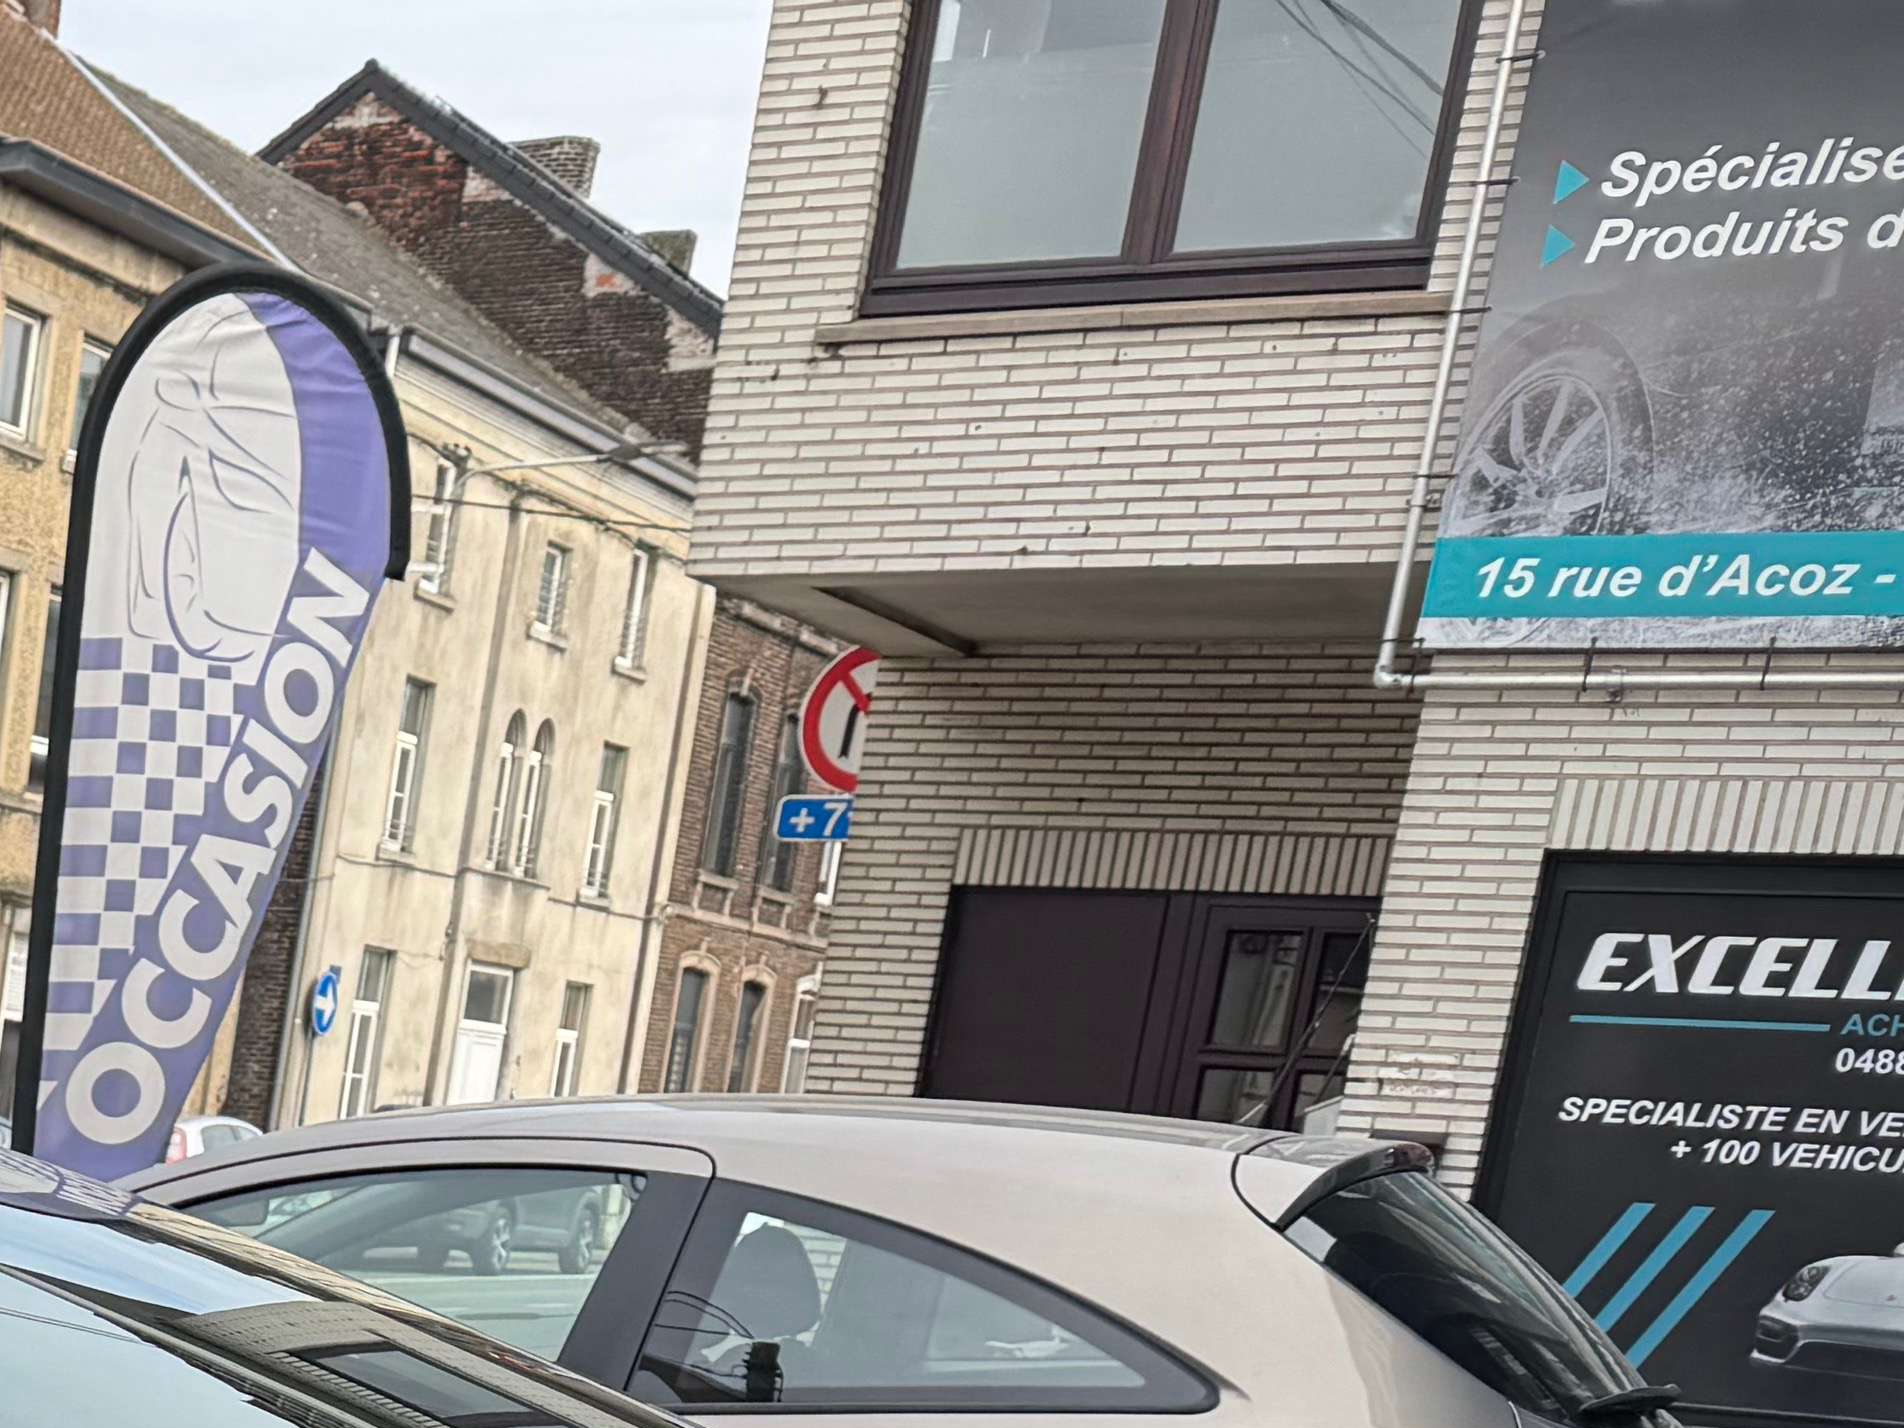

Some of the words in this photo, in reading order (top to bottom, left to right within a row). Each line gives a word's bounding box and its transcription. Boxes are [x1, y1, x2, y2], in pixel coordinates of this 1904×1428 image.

[1584, 208, 1849, 263] Produits
[1475, 558, 1540, 598] 15
[1547, 565, 1642, 598] rue
[1658, 553, 1861, 598] d'Acoz
[822, 802, 853, 837] 7
[65, 546, 371, 1146] OCCASION
[1558, 1097, 1791, 1132] SPECIALISTE
[1793, 1108, 1850, 1134] EN
[1859, 1110, 1904, 1138] VE
[1701, 1139, 1760, 1165] 100
[1771, 1142, 1904, 1173] VEHICU
